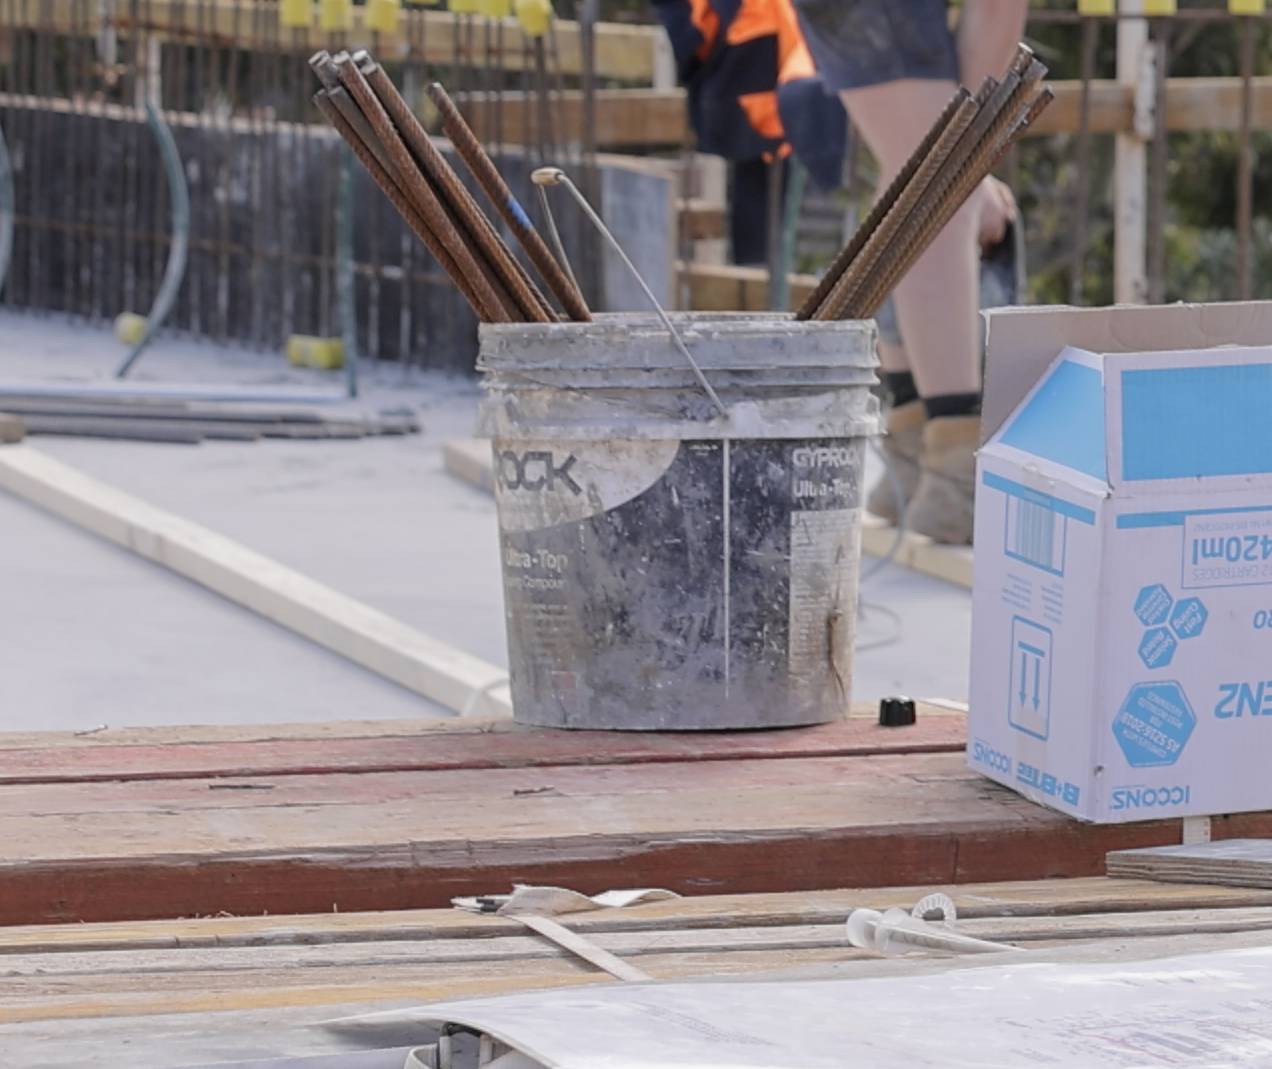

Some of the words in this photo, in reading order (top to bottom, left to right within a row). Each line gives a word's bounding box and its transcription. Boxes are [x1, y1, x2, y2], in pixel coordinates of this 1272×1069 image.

[499, 450, 582, 496] OCK
[1192, 565, 1259, 581] CARTRIDGES
[1261, 564, 1272, 577] 12
[1146, 634, 1173, 666] Seismic
[1166, 737, 1181, 752] AS
[973, 741, 1012, 776] ICCONS
[1110, 785, 1190, 810] ICCONS
